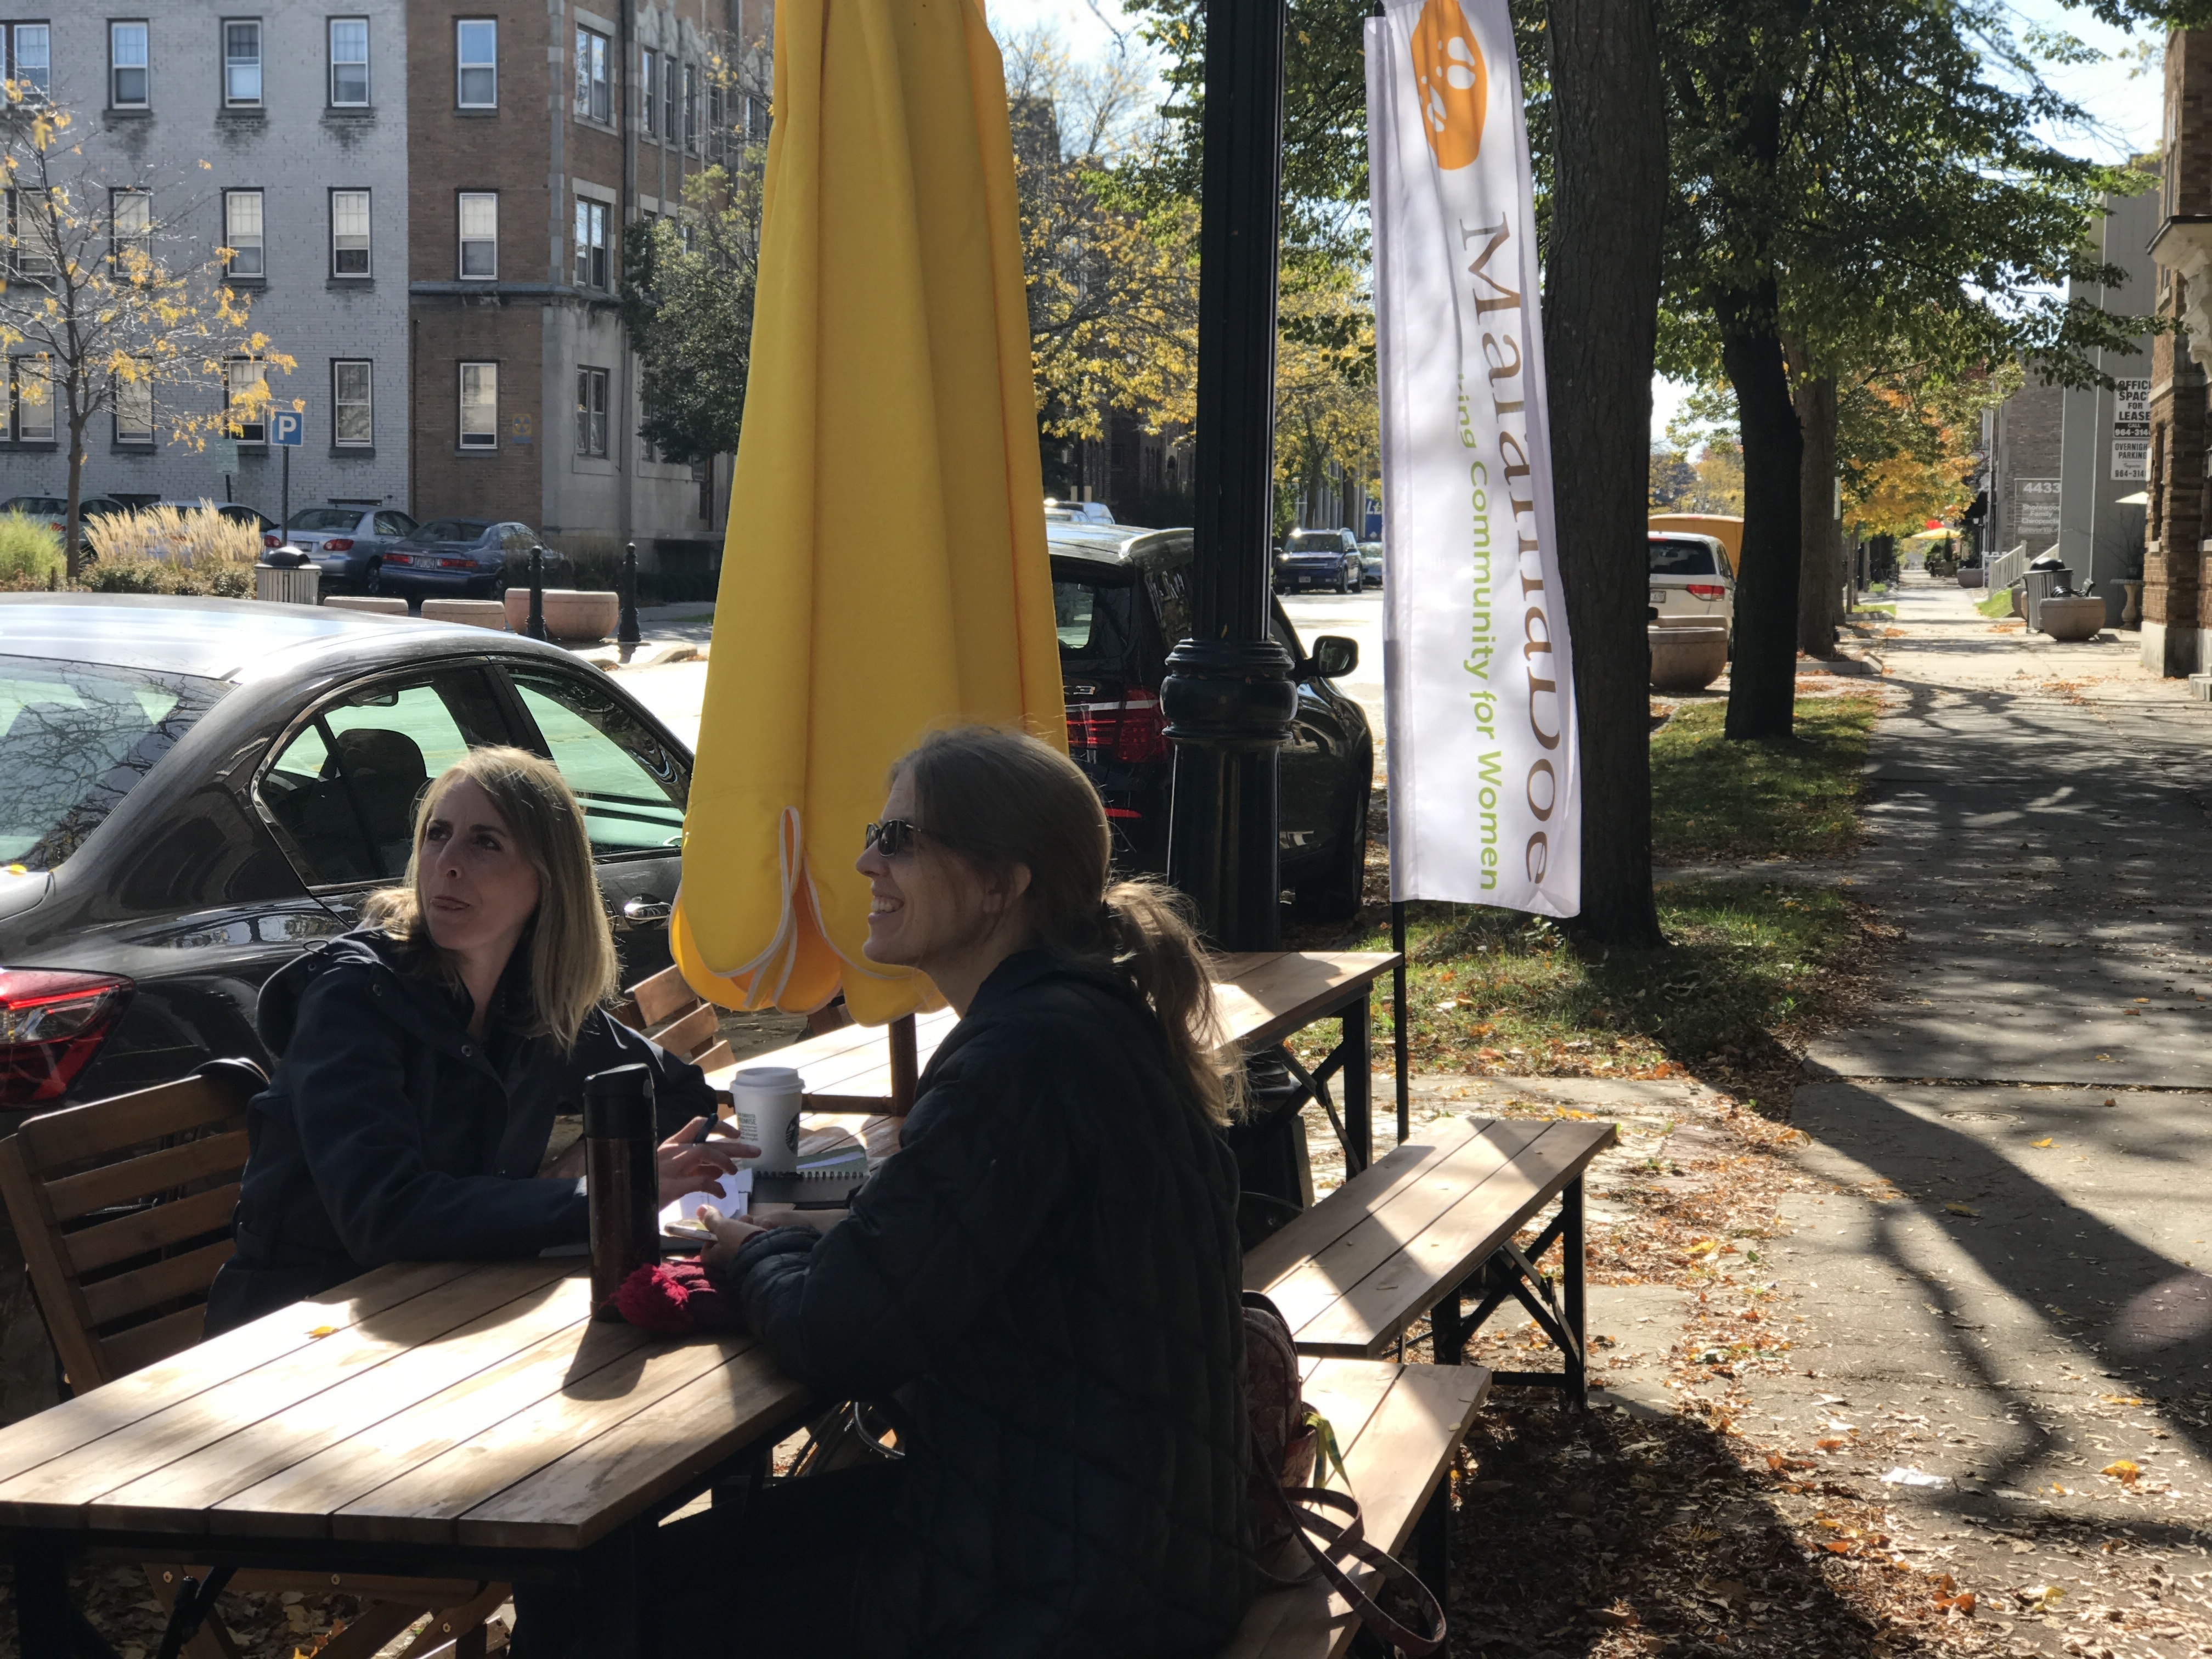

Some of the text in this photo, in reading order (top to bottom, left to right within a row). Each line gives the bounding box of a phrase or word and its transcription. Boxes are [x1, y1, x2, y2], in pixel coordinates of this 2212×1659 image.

[2119, 391, 2150, 401] SPAC
[2119, 411, 2151, 421] LEASE
[278, 415, 296, 441] P
[2115, 443, 2148, 451] OVERNIGH
[2023, 482, 2062, 493] 4433
[1464, 461, 1497, 680] Community
[1469, 691, 1498, 740] for
[1478, 751, 1502, 890] Women
